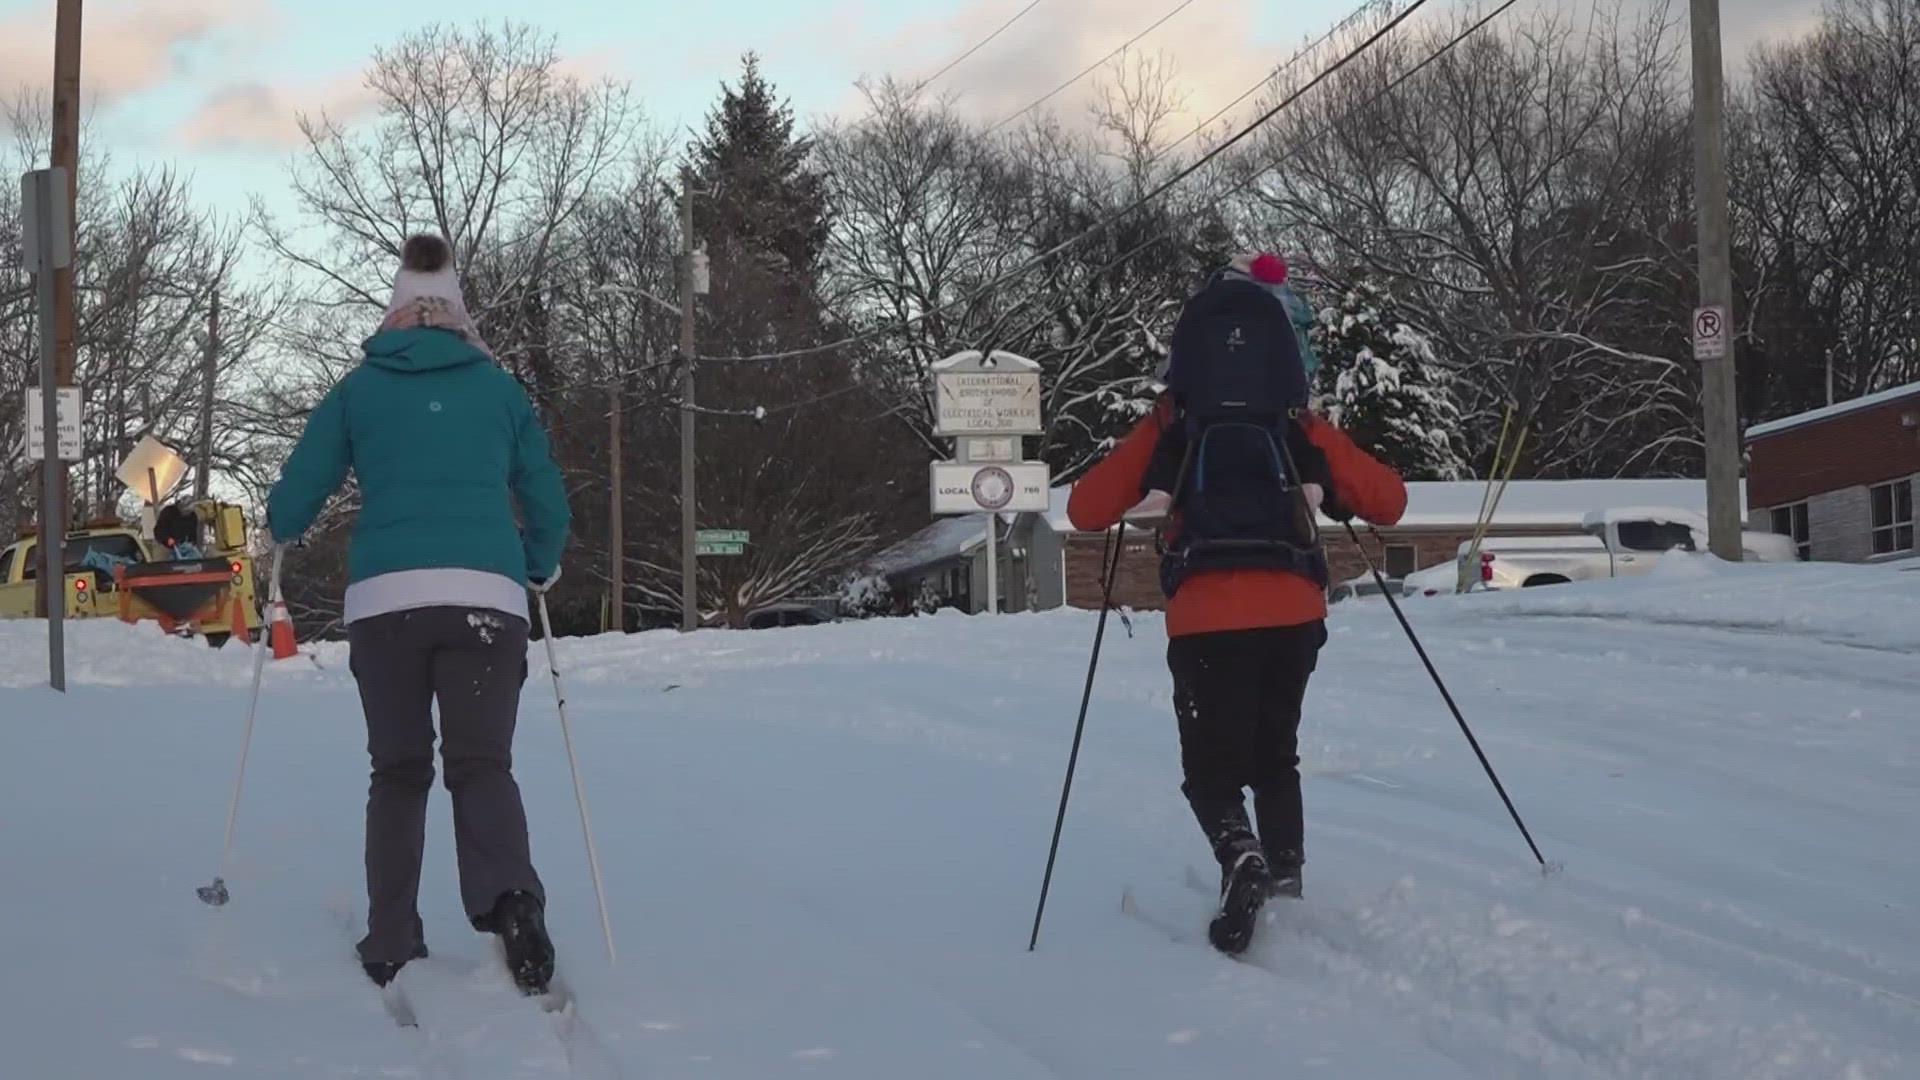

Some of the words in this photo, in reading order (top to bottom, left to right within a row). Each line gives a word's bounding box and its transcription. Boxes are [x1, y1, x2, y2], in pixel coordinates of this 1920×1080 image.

[957, 377, 1021, 386] INTERNATIONAL
[959, 388, 1018, 397] BROTHERHOOD
[942, 408, 993, 418] ELECTRICAL
[996, 408, 1036, 418] WORKERS
[966, 419, 993, 428] LOCAL
[938, 486, 971, 495] LOCAL
